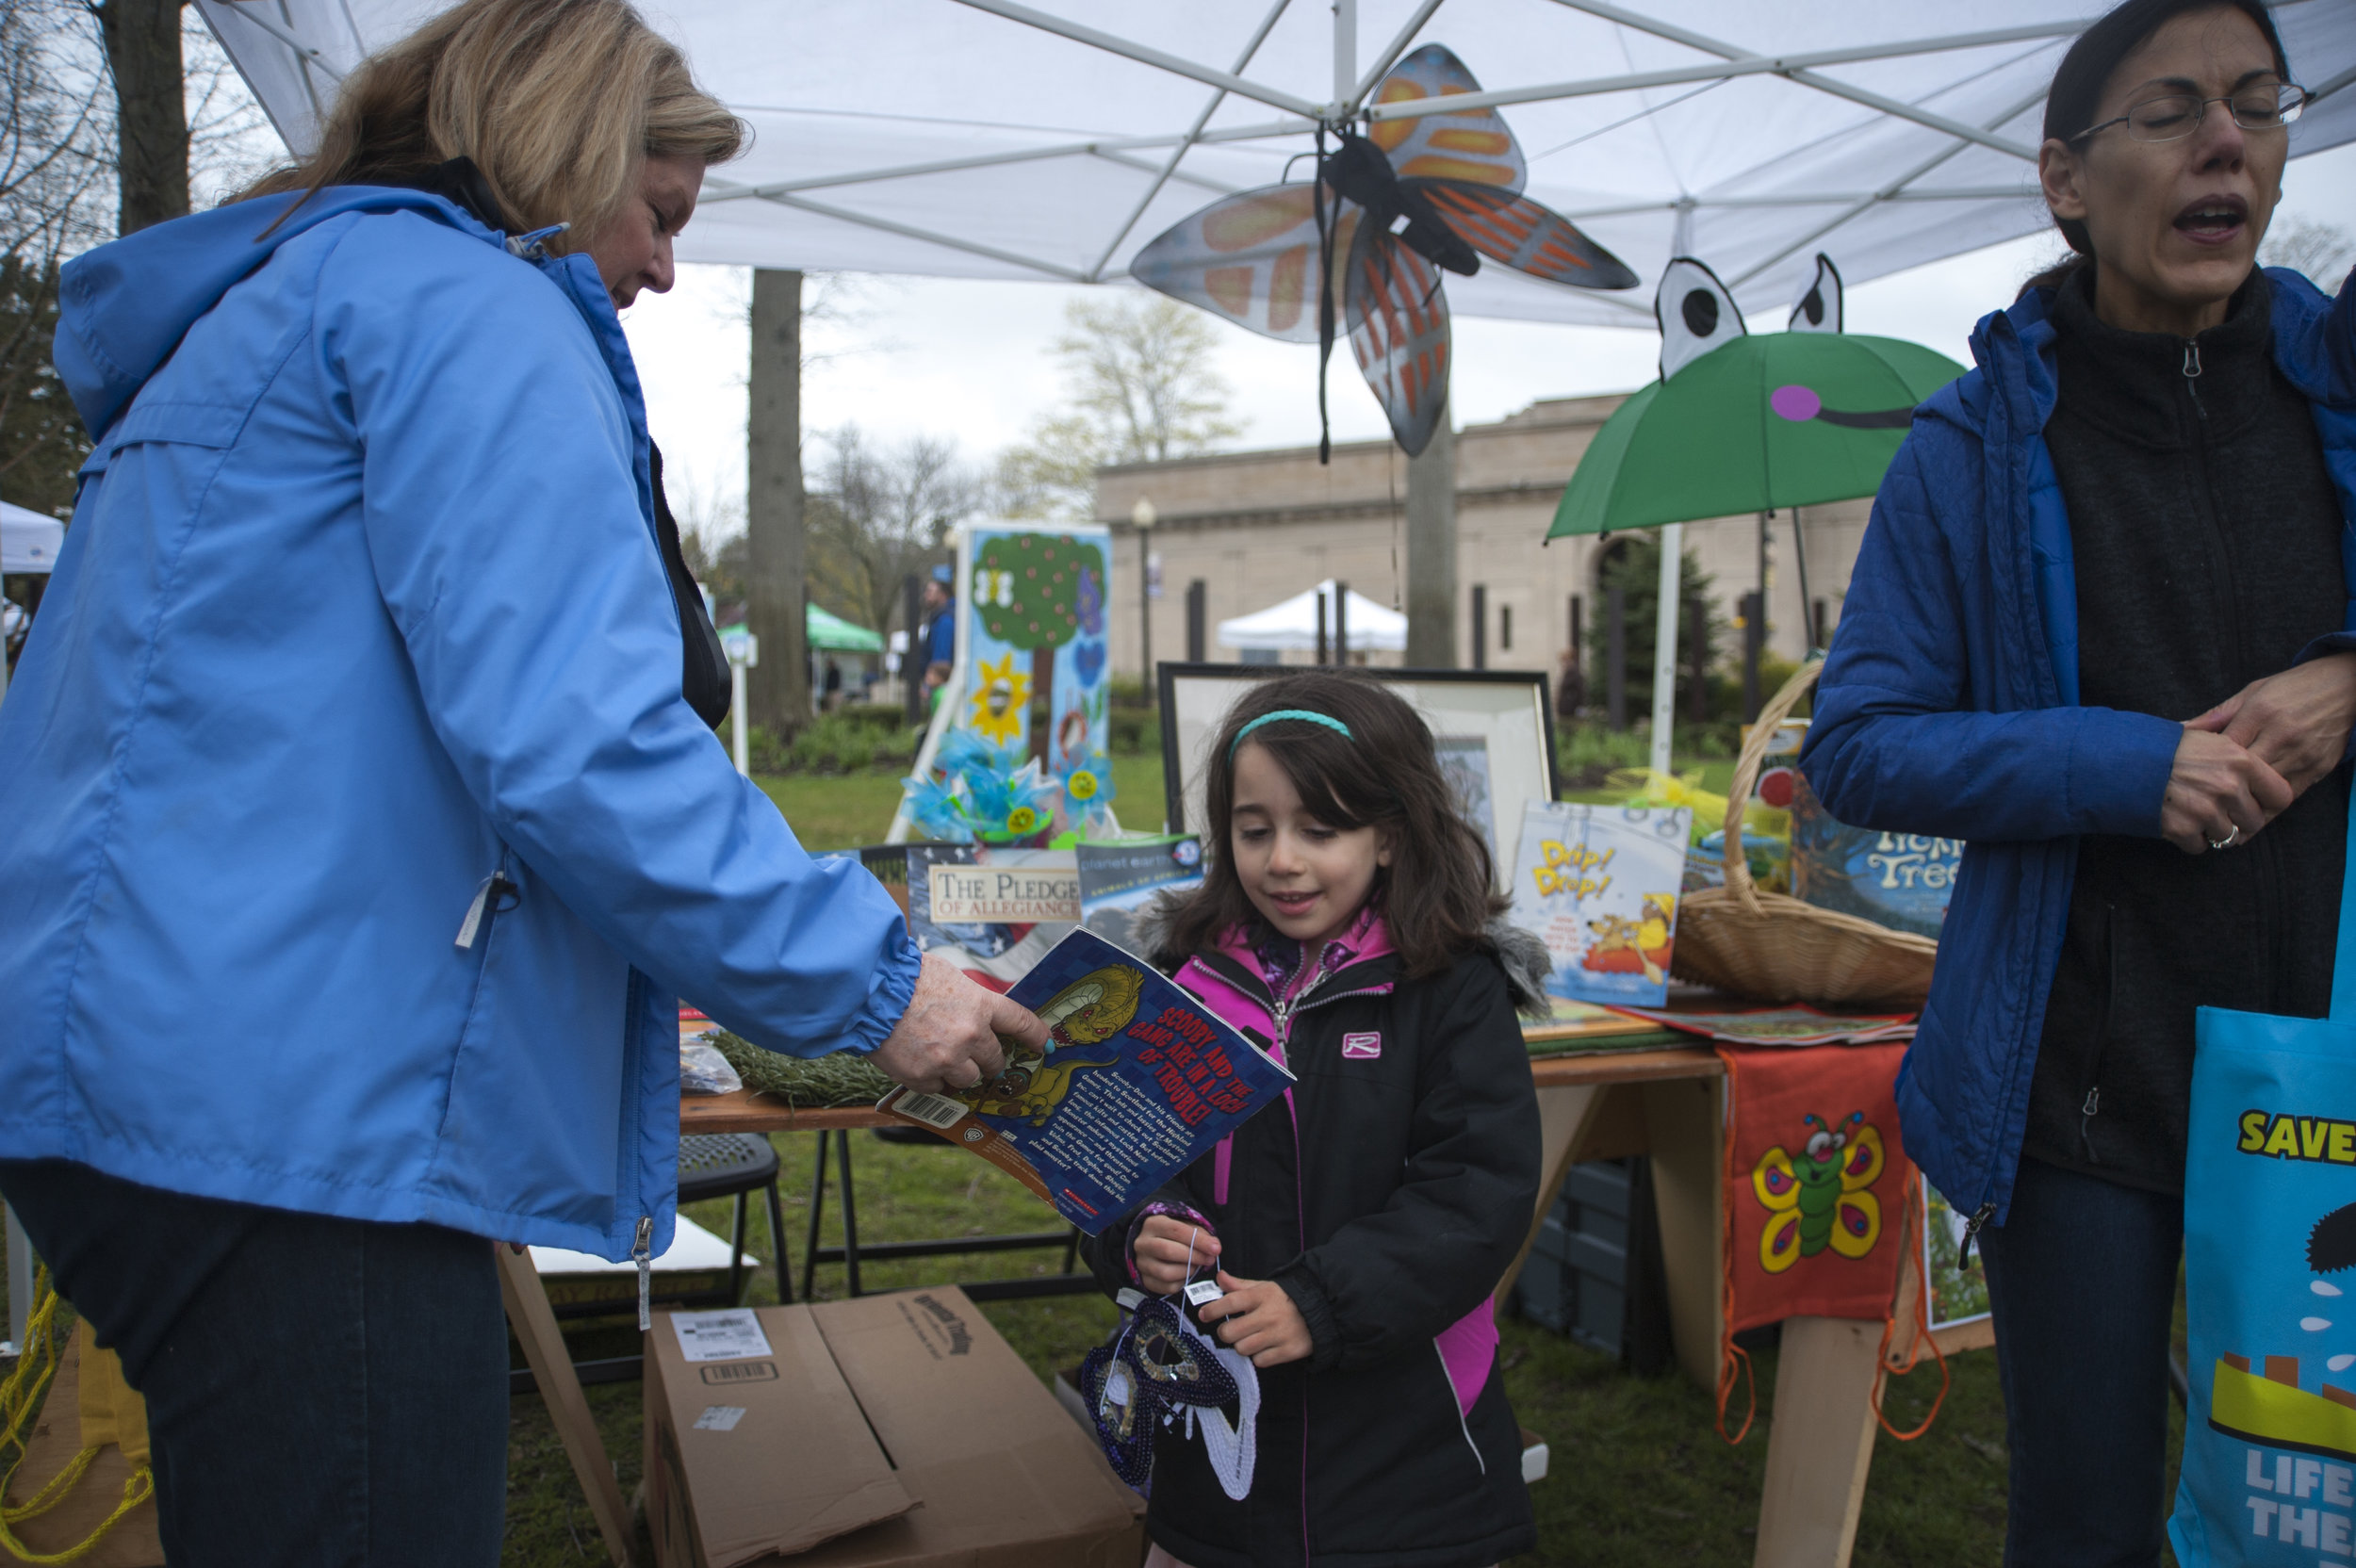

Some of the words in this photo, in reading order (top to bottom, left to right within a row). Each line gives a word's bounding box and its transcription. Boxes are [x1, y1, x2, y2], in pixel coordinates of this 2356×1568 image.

[1531, 867, 1612, 901] Drop!
[1540, 840, 1616, 873] Drip!
[938, 873, 985, 900] THE
[996, 873, 1078, 900] PLEDGE
[939, 901, 968, 915] OF
[972, 900, 1080, 916] ALLEGIANCE
[1127, 1021, 1175, 1048] GANG
[1157, 1006, 1219, 1050] SCOOBY
[1203, 1045, 1234, 1078] AND
[1225, 1076, 1255, 1099] THE
[1165, 1040, 1199, 1070] ARE
[1137, 1048, 1165, 1066] OF
[1154, 1061, 1213, 1127] TROUBLE!
[1186, 1062, 1210, 1085] IN
[1196, 1078, 1218, 1096] A
[1206, 1088, 1251, 1114] LOCH
[1072, 1091, 1094, 1107] famous
[1092, 1105, 1108, 1118] kilts
[1106, 1117, 1120, 1126] and
[1139, 1142, 1152, 1153] But
[1151, 1152, 1170, 1166] before
[1088, 1091, 1104, 1103] can't
[1104, 1102, 1118, 1113] wait
[1123, 1118, 1142, 1134] check
[1140, 1132, 1153, 1142] out
[1152, 1140, 1182, 1163] Scotland's
[1092, 1070, 1114, 1086] headed
[1121, 1090, 1147, 1111] Scotland
[1145, 1110, 1156, 1119] for
[1155, 1119, 1167, 1129] the
[1165, 1127, 1192, 1147] Highland
[1104, 1088, 1116, 1100] The
[1115, 1097, 1128, 1109] lads
[1126, 1107, 1139, 1118] and
[1137, 1115, 1157, 1133] lassies
[1111, 1071, 1146, 1099] Scooby-Doo
[1144, 1098, 1157, 1107] and
[1154, 1104, 1166, 1115] his
[1165, 1114, 1186, 1132] friends
[1028, 1139, 1045, 1152] plaid
[1043, 1150, 1072, 1170] monster?
[1052, 1122, 1065, 1133] ruin
[1065, 1131, 1076, 1140] the
[1075, 1139, 1095, 1155] Games
[1093, 1153, 1104, 1163] for
[1104, 1163, 1122, 1176] good!
[1120, 1174, 1131, 1184] Can
[1056, 1115, 1088, 1137] appearance
[1093, 1142, 1106, 1152] and
[1104, 1150, 1132, 1173] threatens
[1062, 1106, 1088, 1125] Monster
[1087, 1124, 1104, 1139] makes
[1108, 1141, 1138, 1167] mysterious
[1084, 1110, 1095, 1119] the
[1094, 1118, 1121, 1139] infamous
[1119, 1137, 1134, 1152] Loch
[1133, 1150, 1149, 1163] Ness
[2238, 1110, 2356, 1165] SAVE
[1040, 1137, 1054, 1146] and
[1052, 1144, 1073, 1162] Scooby
[1072, 1160, 1088, 1174] track
[1088, 1173, 1104, 1186] down
[1103, 1184, 1116, 1196] this
[2246, 1448, 2355, 1509] LIFE
[2246, 1495, 2356, 1558] THE
